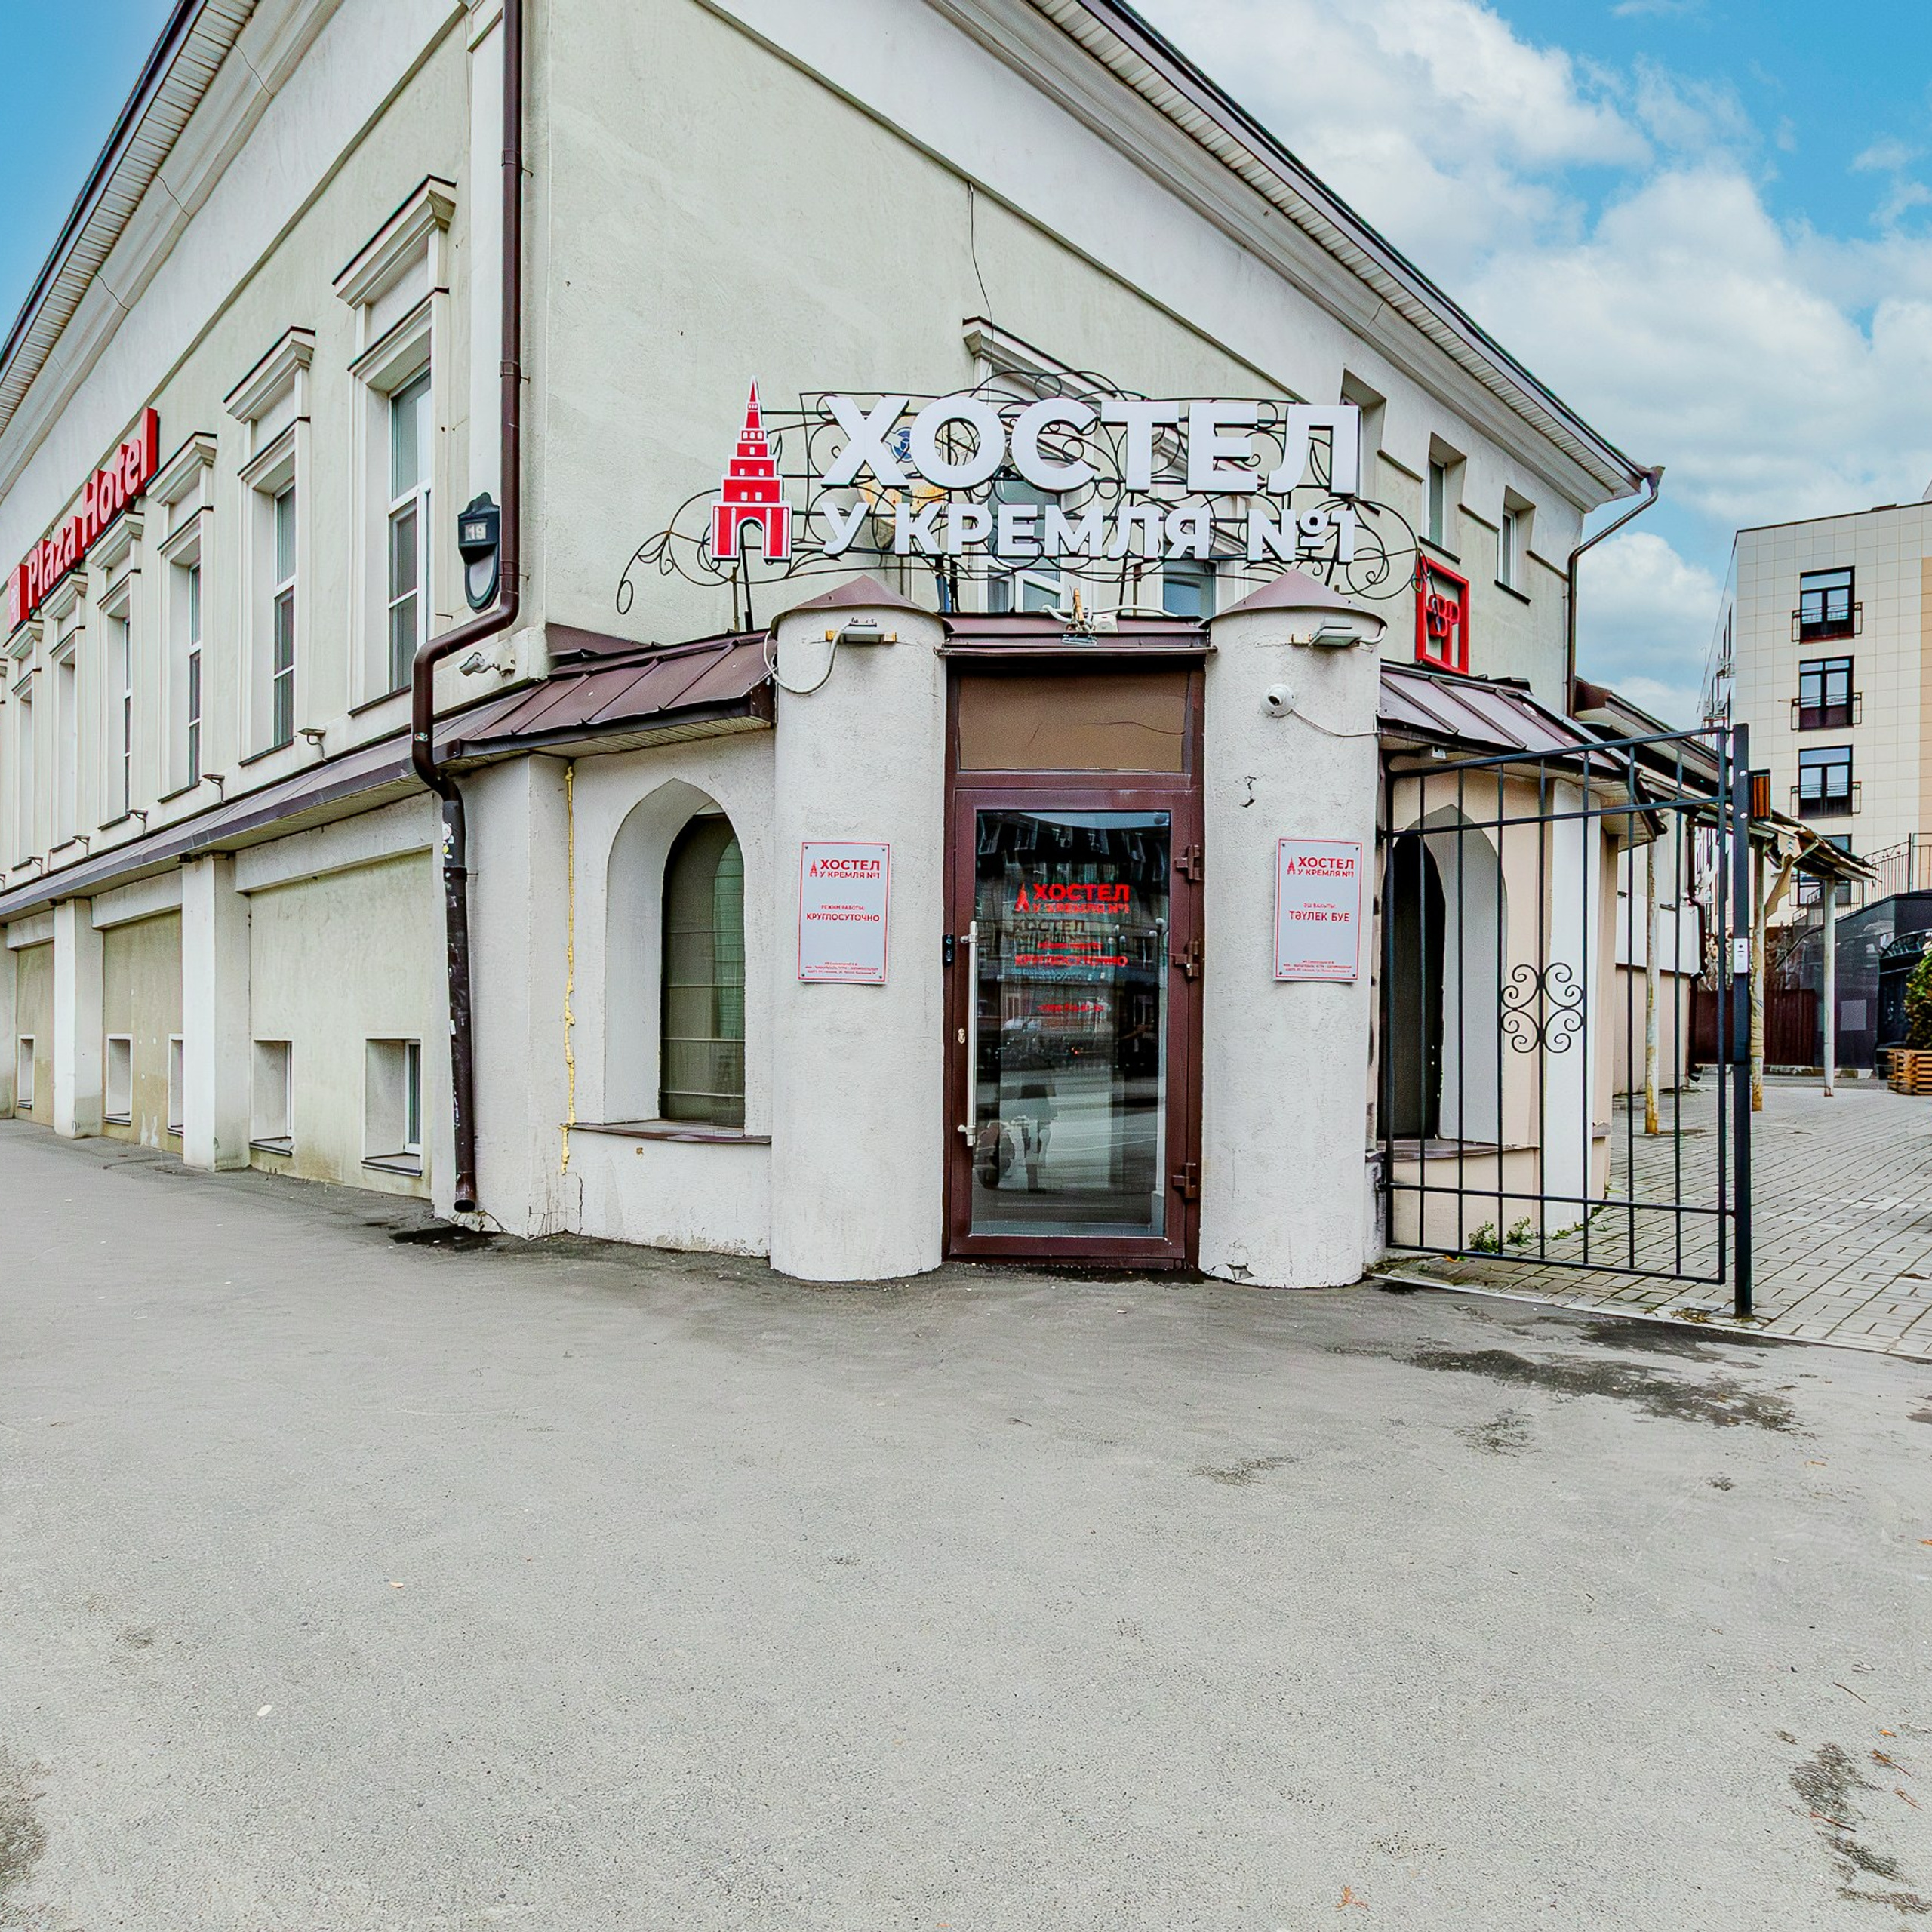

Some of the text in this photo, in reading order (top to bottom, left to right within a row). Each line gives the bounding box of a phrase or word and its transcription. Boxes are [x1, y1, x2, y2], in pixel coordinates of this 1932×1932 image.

[821, 395, 1360, 496] ХОСТЕЛ
[27, 407, 158, 610] Plaza Hotel
[819, 501, 1356, 563] У КРЕМЛЯ №1
[820, 859, 881, 871] ХОСТЕЛ
[1298, 857, 1355, 869] ХОСТЕЛ
[1033, 882, 1131, 902] ХОСТЕЛ
[806, 912, 881, 922] КРУГЛОСУТОЧНО
[1331, 912, 1350, 922] БУЕ
